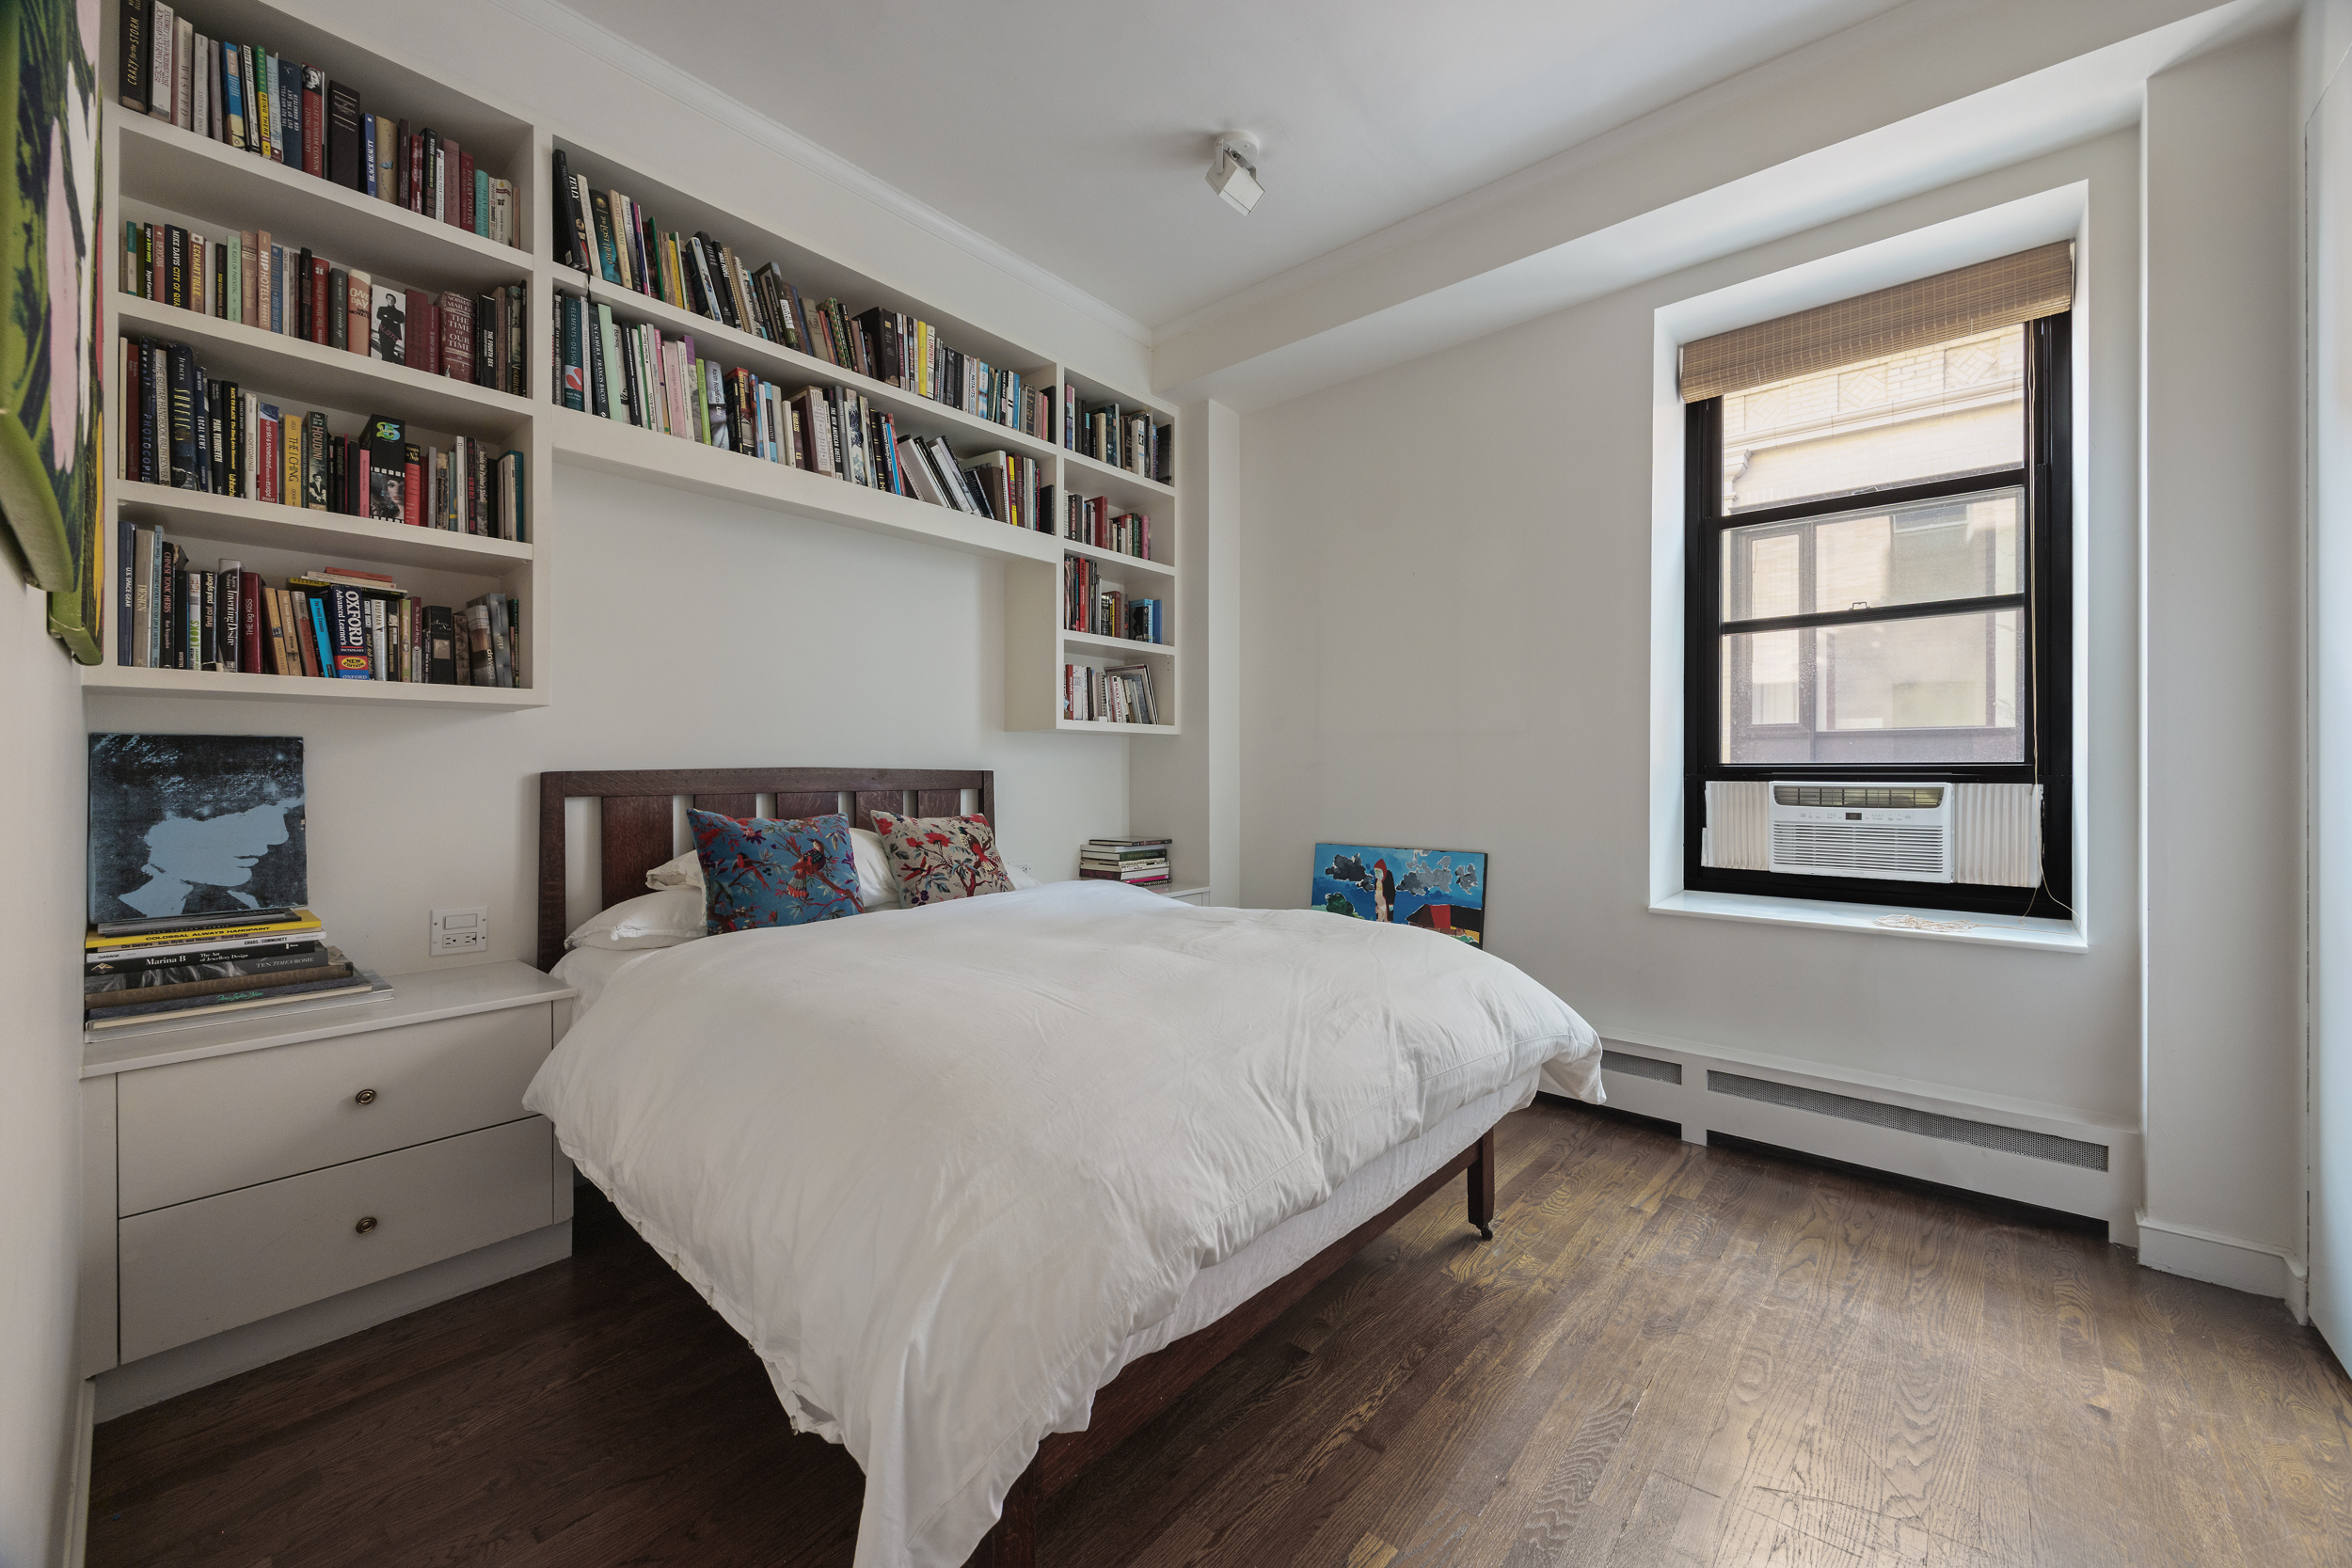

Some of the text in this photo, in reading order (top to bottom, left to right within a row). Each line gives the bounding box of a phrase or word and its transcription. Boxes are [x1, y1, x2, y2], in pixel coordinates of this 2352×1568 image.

[129, 17, 140, 44] STORM
[127, 59, 139, 86] CRAZY
[154, 59, 163, 83] FOER
[180, 65, 189, 117] WASTED
[262, 117, 270, 137] THERE
[568, 176, 580, 202] ITALY
[599, 225, 613, 265] LOST HERO
[172, 230, 181, 307] MIKE DAVIS CITY OF QUA
[193, 245, 201, 296] ECKHART TOLLE
[261, 250, 269, 271] HIP
[260, 271, 269, 302] HOTELS
[349, 287, 370, 301] ONE
[350, 297, 369, 309] DAY
[448, 320, 471, 332] TIME
[451, 313, 469, 324] THE
[447, 339, 470, 352] TIME
[449, 333, 470, 344] OUR
[156, 376, 168, 479] GUITAR HANDBOOK RALPH DENYER
[212, 418, 223, 463] PAUL VERHOEVEN
[312, 426, 324, 461] HOUDINI
[288, 436, 300, 483] THE CHING
[136, 584, 148, 612] DESIGN
[246, 613, 255, 623] big
[336, 589, 347, 646] Advanced Learner's
[345, 590, 364, 646] OXFORD
[191, 620, 199, 647] LOOKS
[486, 649, 496, 680] blowup
[146, 956, 178, 966] Marina
